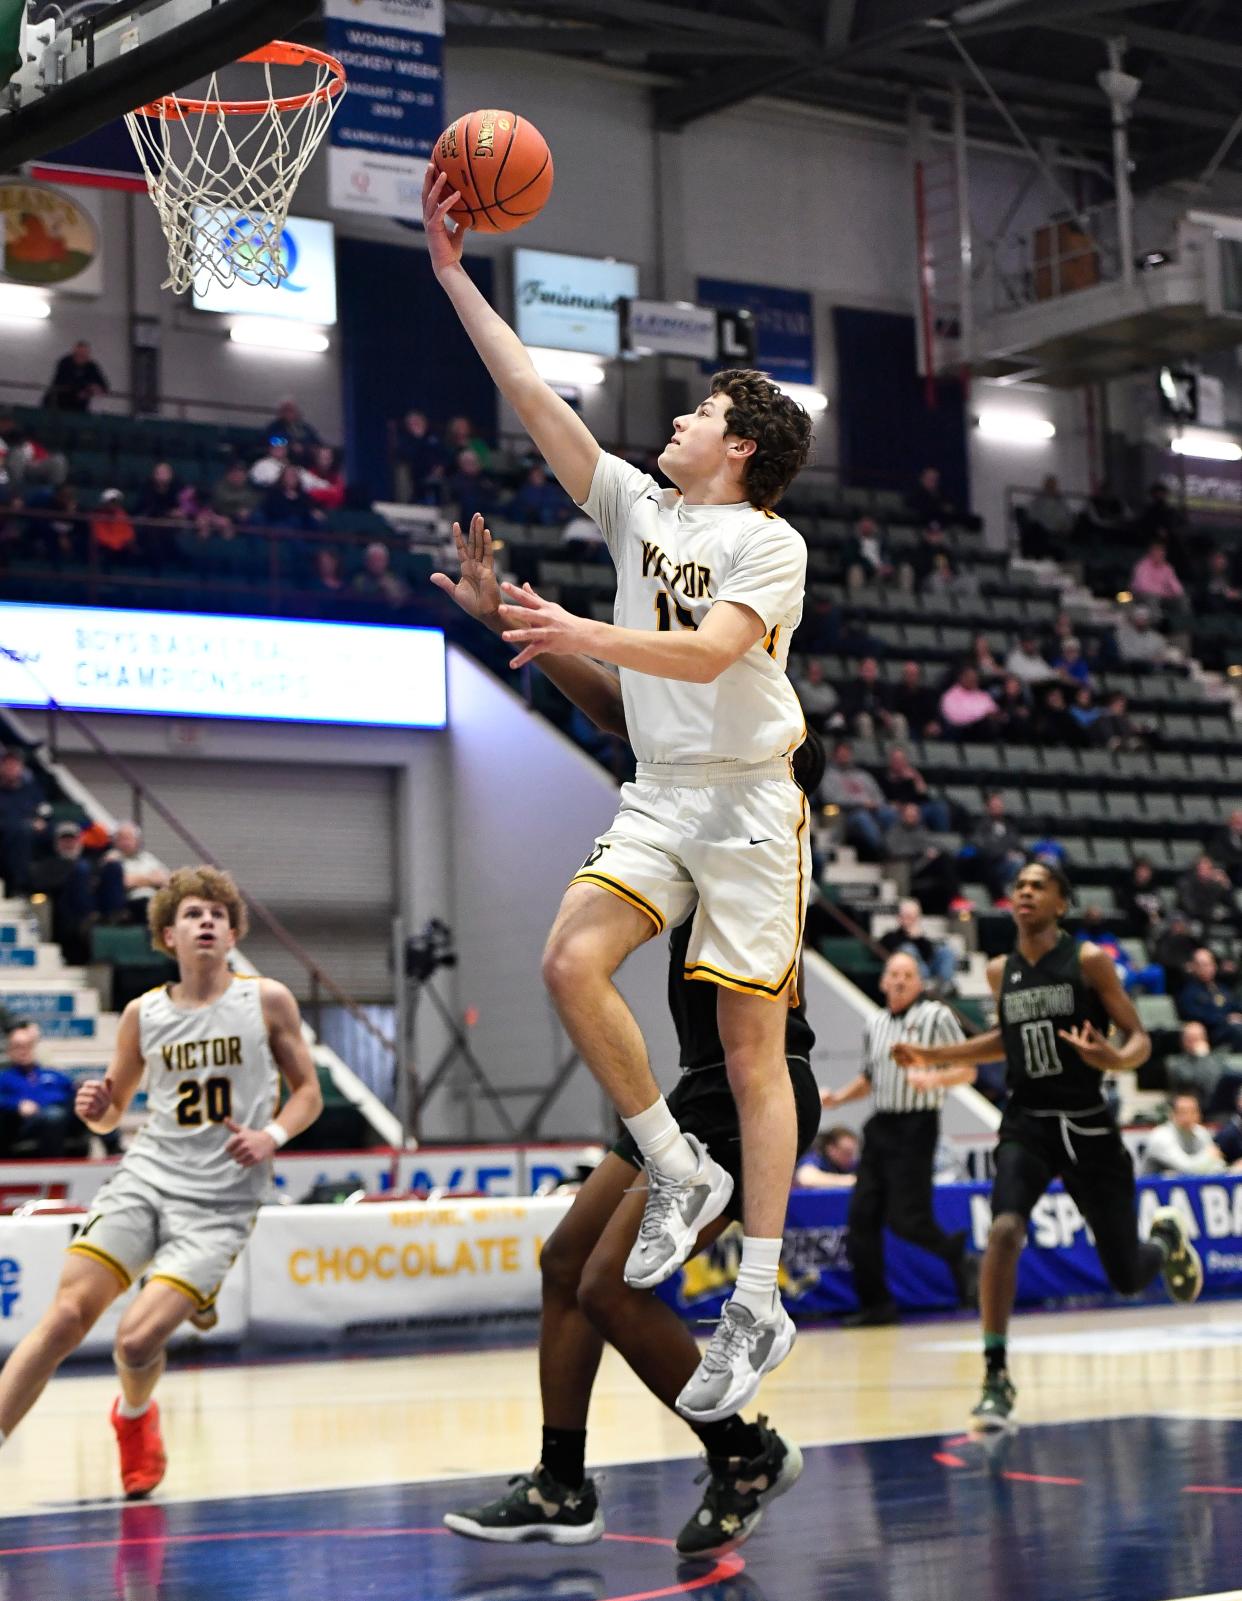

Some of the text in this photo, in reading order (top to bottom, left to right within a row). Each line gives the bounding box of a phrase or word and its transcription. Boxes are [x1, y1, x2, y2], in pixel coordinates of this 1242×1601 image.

[345, 29, 424, 56] WOMEN'S
[396, 59, 441, 80] WEEK
[75, 628, 138, 653] BOYS
[75, 661, 311, 699] CHAMPIONSHIPS
[162, 1036, 242, 1071] VICTOR
[177, 1077, 231, 1126] 20
[288, 1236, 519, 1285] CHOCOLATE
